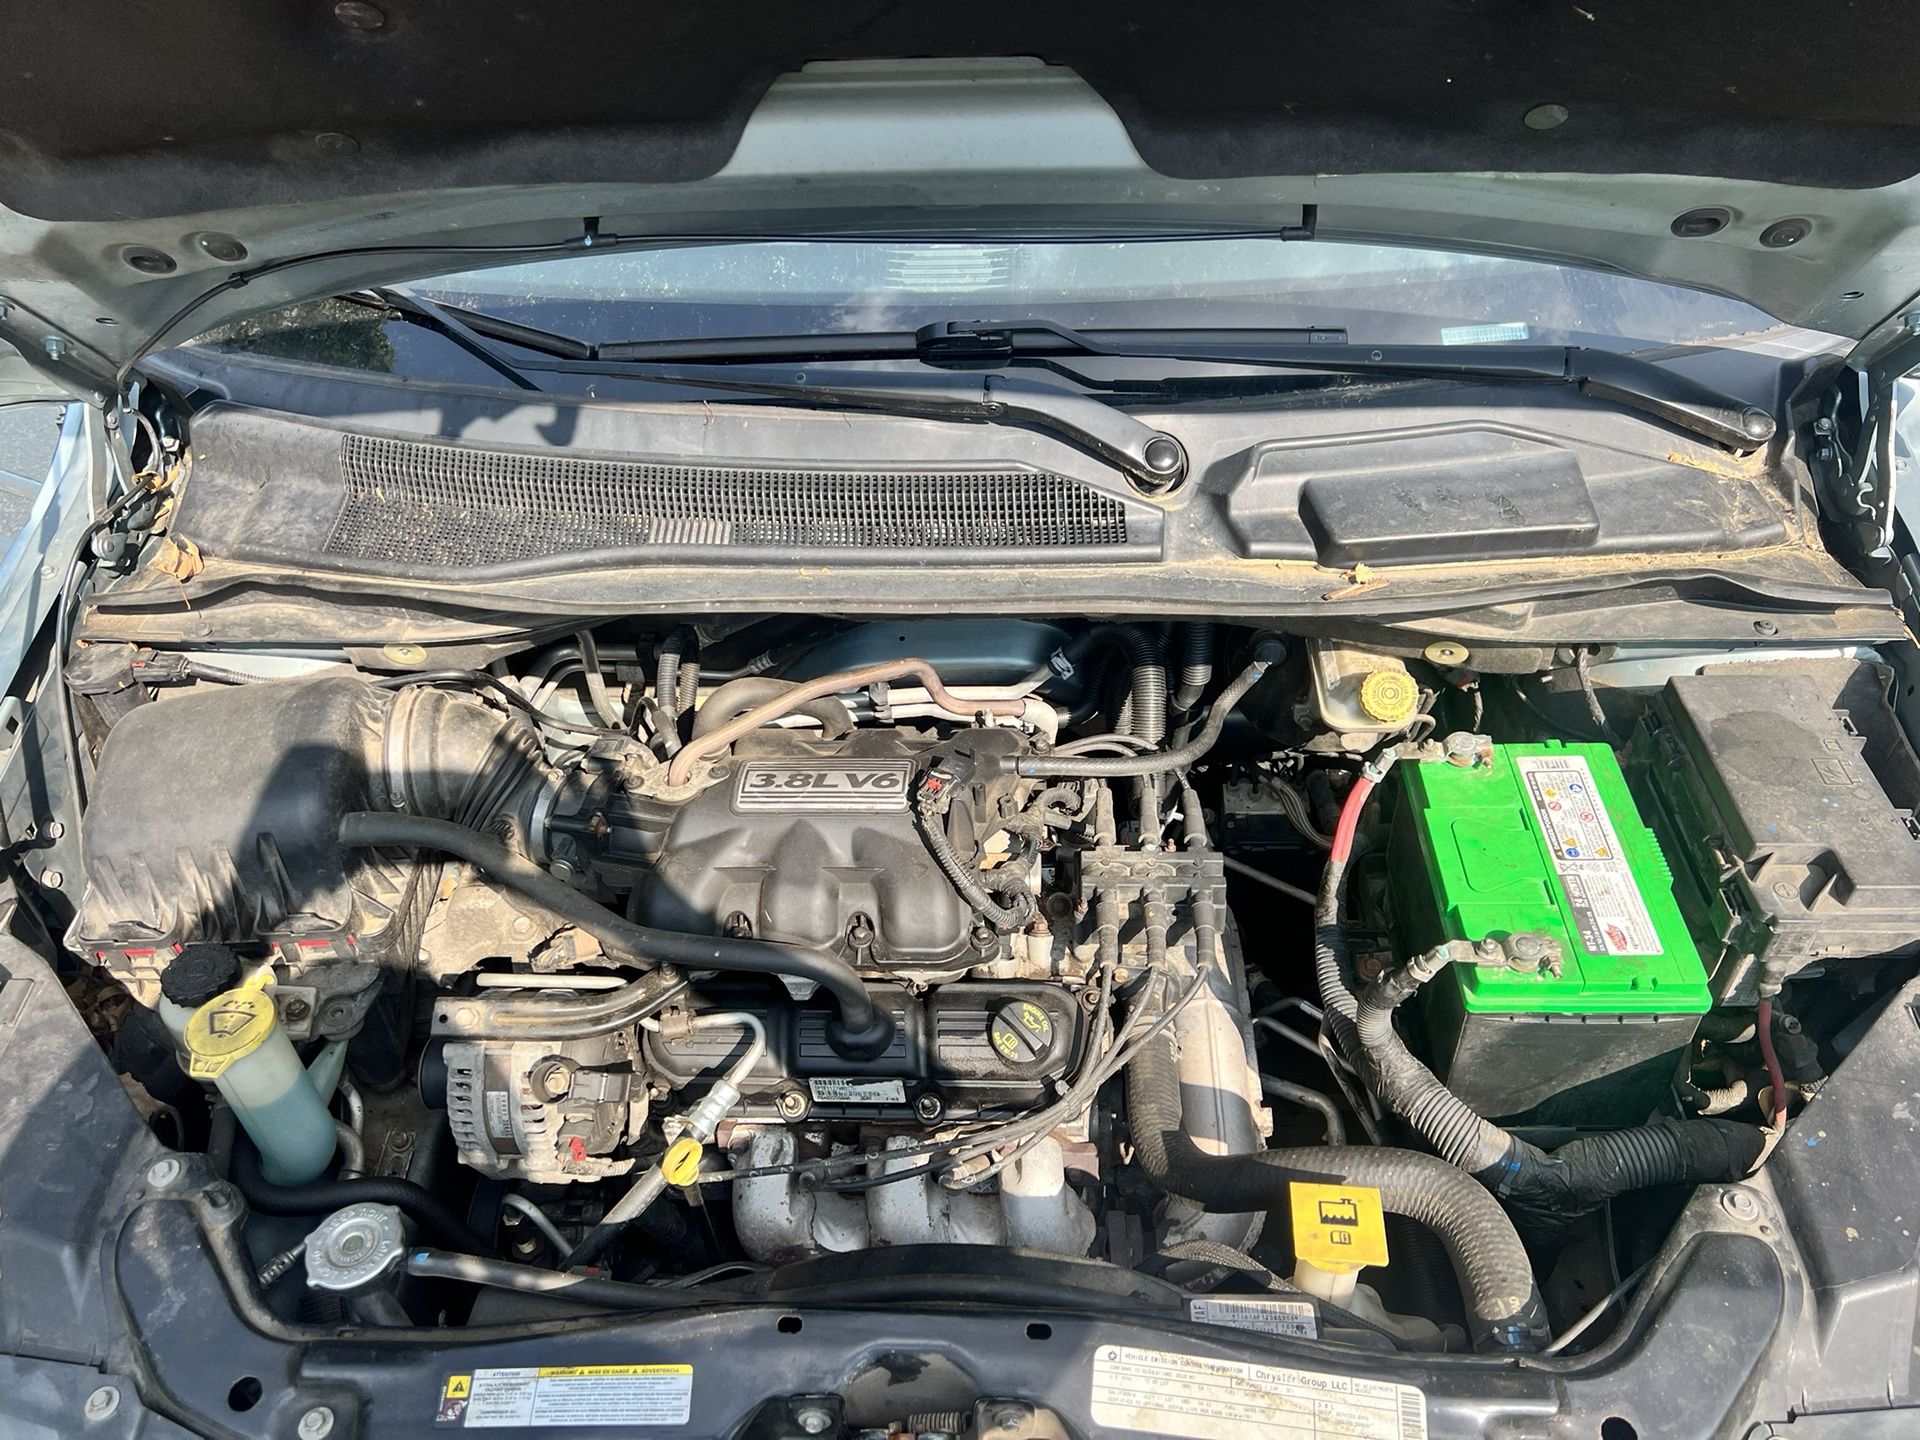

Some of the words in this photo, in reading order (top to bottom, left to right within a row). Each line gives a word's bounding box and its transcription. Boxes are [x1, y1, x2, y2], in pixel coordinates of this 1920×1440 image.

[749, 772, 838, 789] 3.8L
[845, 772, 900, 789] V6
[1023, 1003, 1044, 1022] ENGINE
[1041, 1020, 1050, 1033] OIL
[1124, 1352, 1147, 1361] VEHICLE
[1150, 1355, 1177, 1365] EMISSION
[1180, 1359, 1202, 1368] CONTROL
[1300, 1375, 1327, 1389] Group
[1331, 1379, 1347, 1391] LLC
